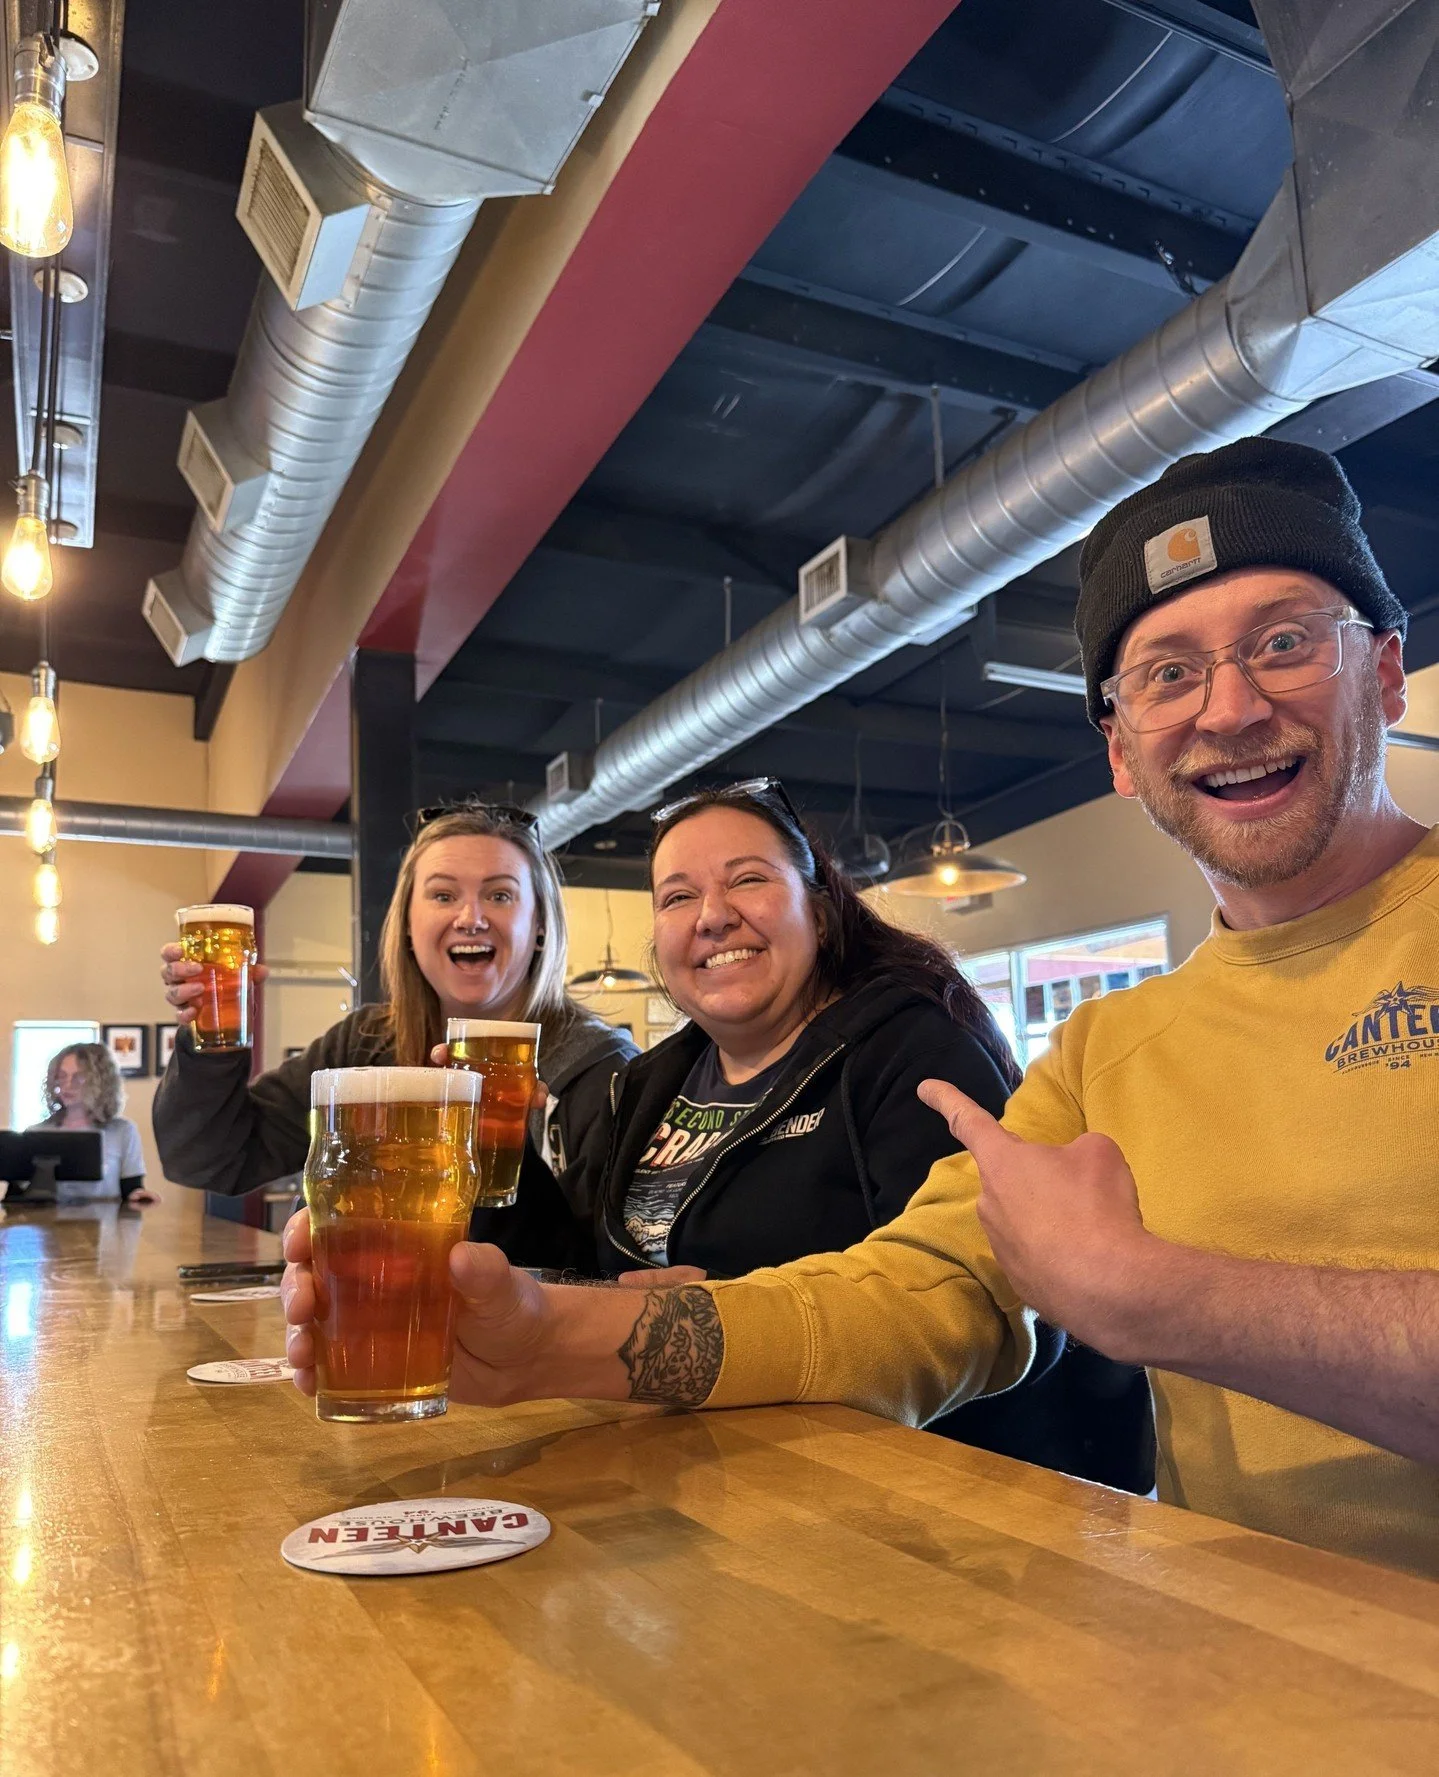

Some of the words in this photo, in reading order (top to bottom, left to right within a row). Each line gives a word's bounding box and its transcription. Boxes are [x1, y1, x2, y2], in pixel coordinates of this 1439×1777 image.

[1160, 557, 1201, 579] carhartt
[1337, 1039, 1439, 1069] BREWHOU
[308, 1512, 529, 1544] CANTEEN
[339, 1509, 503, 1526] BREWHOUSE
